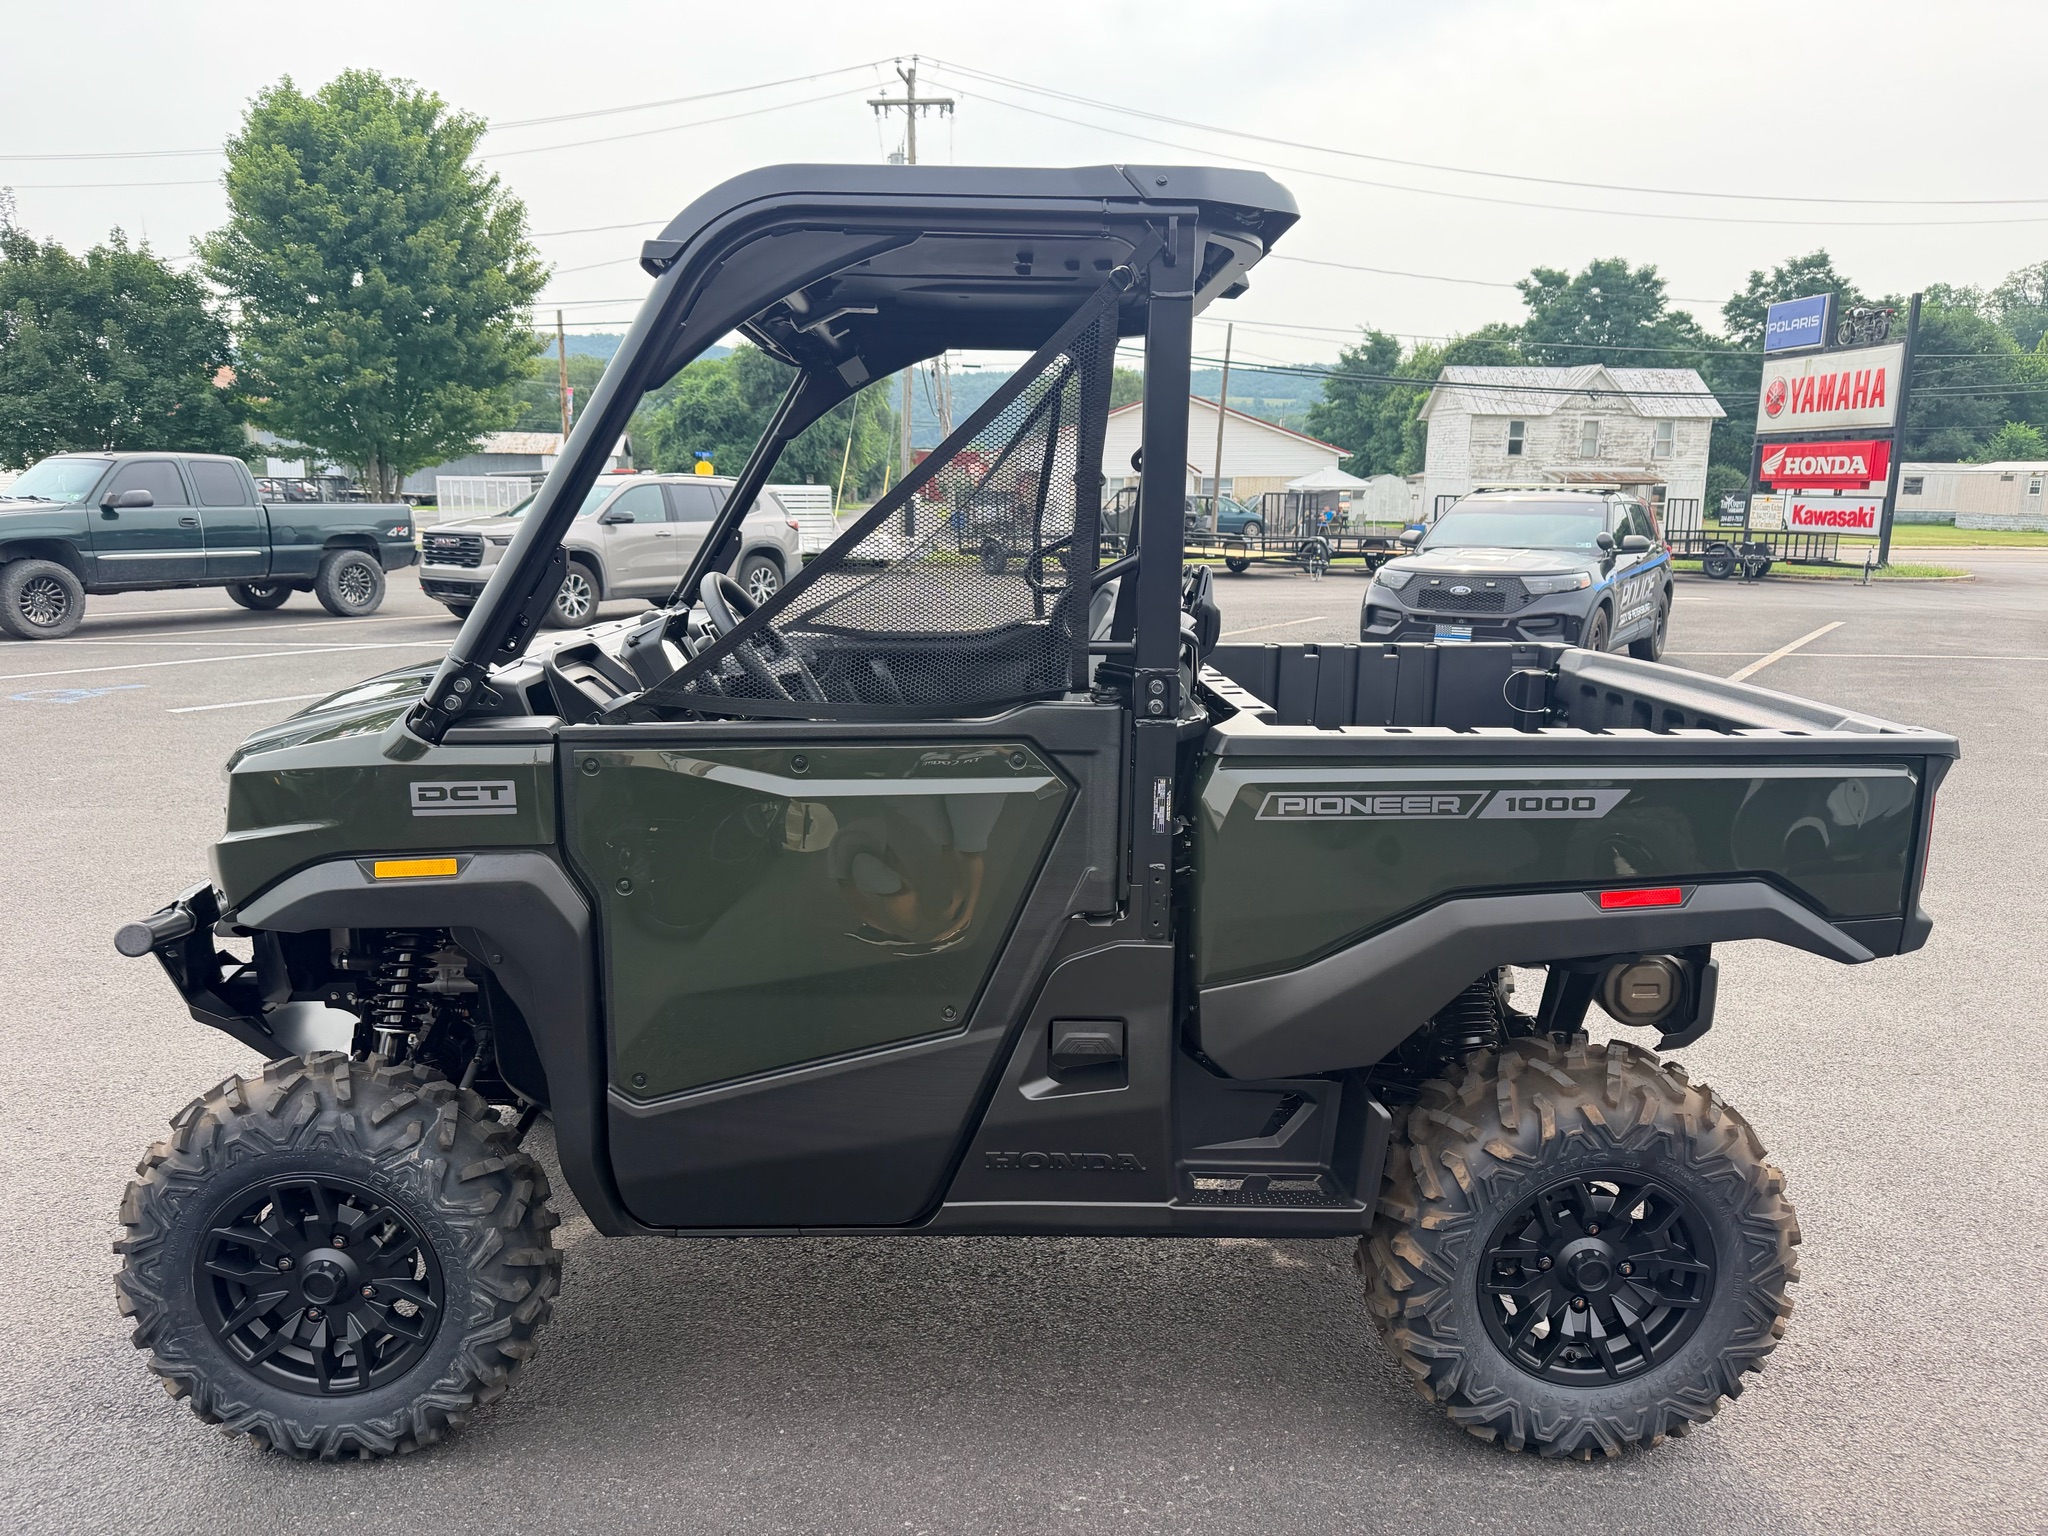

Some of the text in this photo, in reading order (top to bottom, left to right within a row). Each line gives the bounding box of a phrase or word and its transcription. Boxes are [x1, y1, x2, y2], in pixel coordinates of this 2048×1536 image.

[1768, 315, 1820, 334] POLARIS
[1791, 367, 1885, 414] YAMAHA
[1783, 456, 1868, 475] HONDA
[1792, 504, 1875, 528] Kawasaki
[435, 537, 460, 547] GMC
[1620, 573, 1656, 608] POLICE
[418, 786, 508, 801] DCT
[1278, 797, 1596, 814] PIONEER 1000
[985, 1151, 1147, 1171] HONDA
[366, 1170, 463, 1274] BIGHORN
